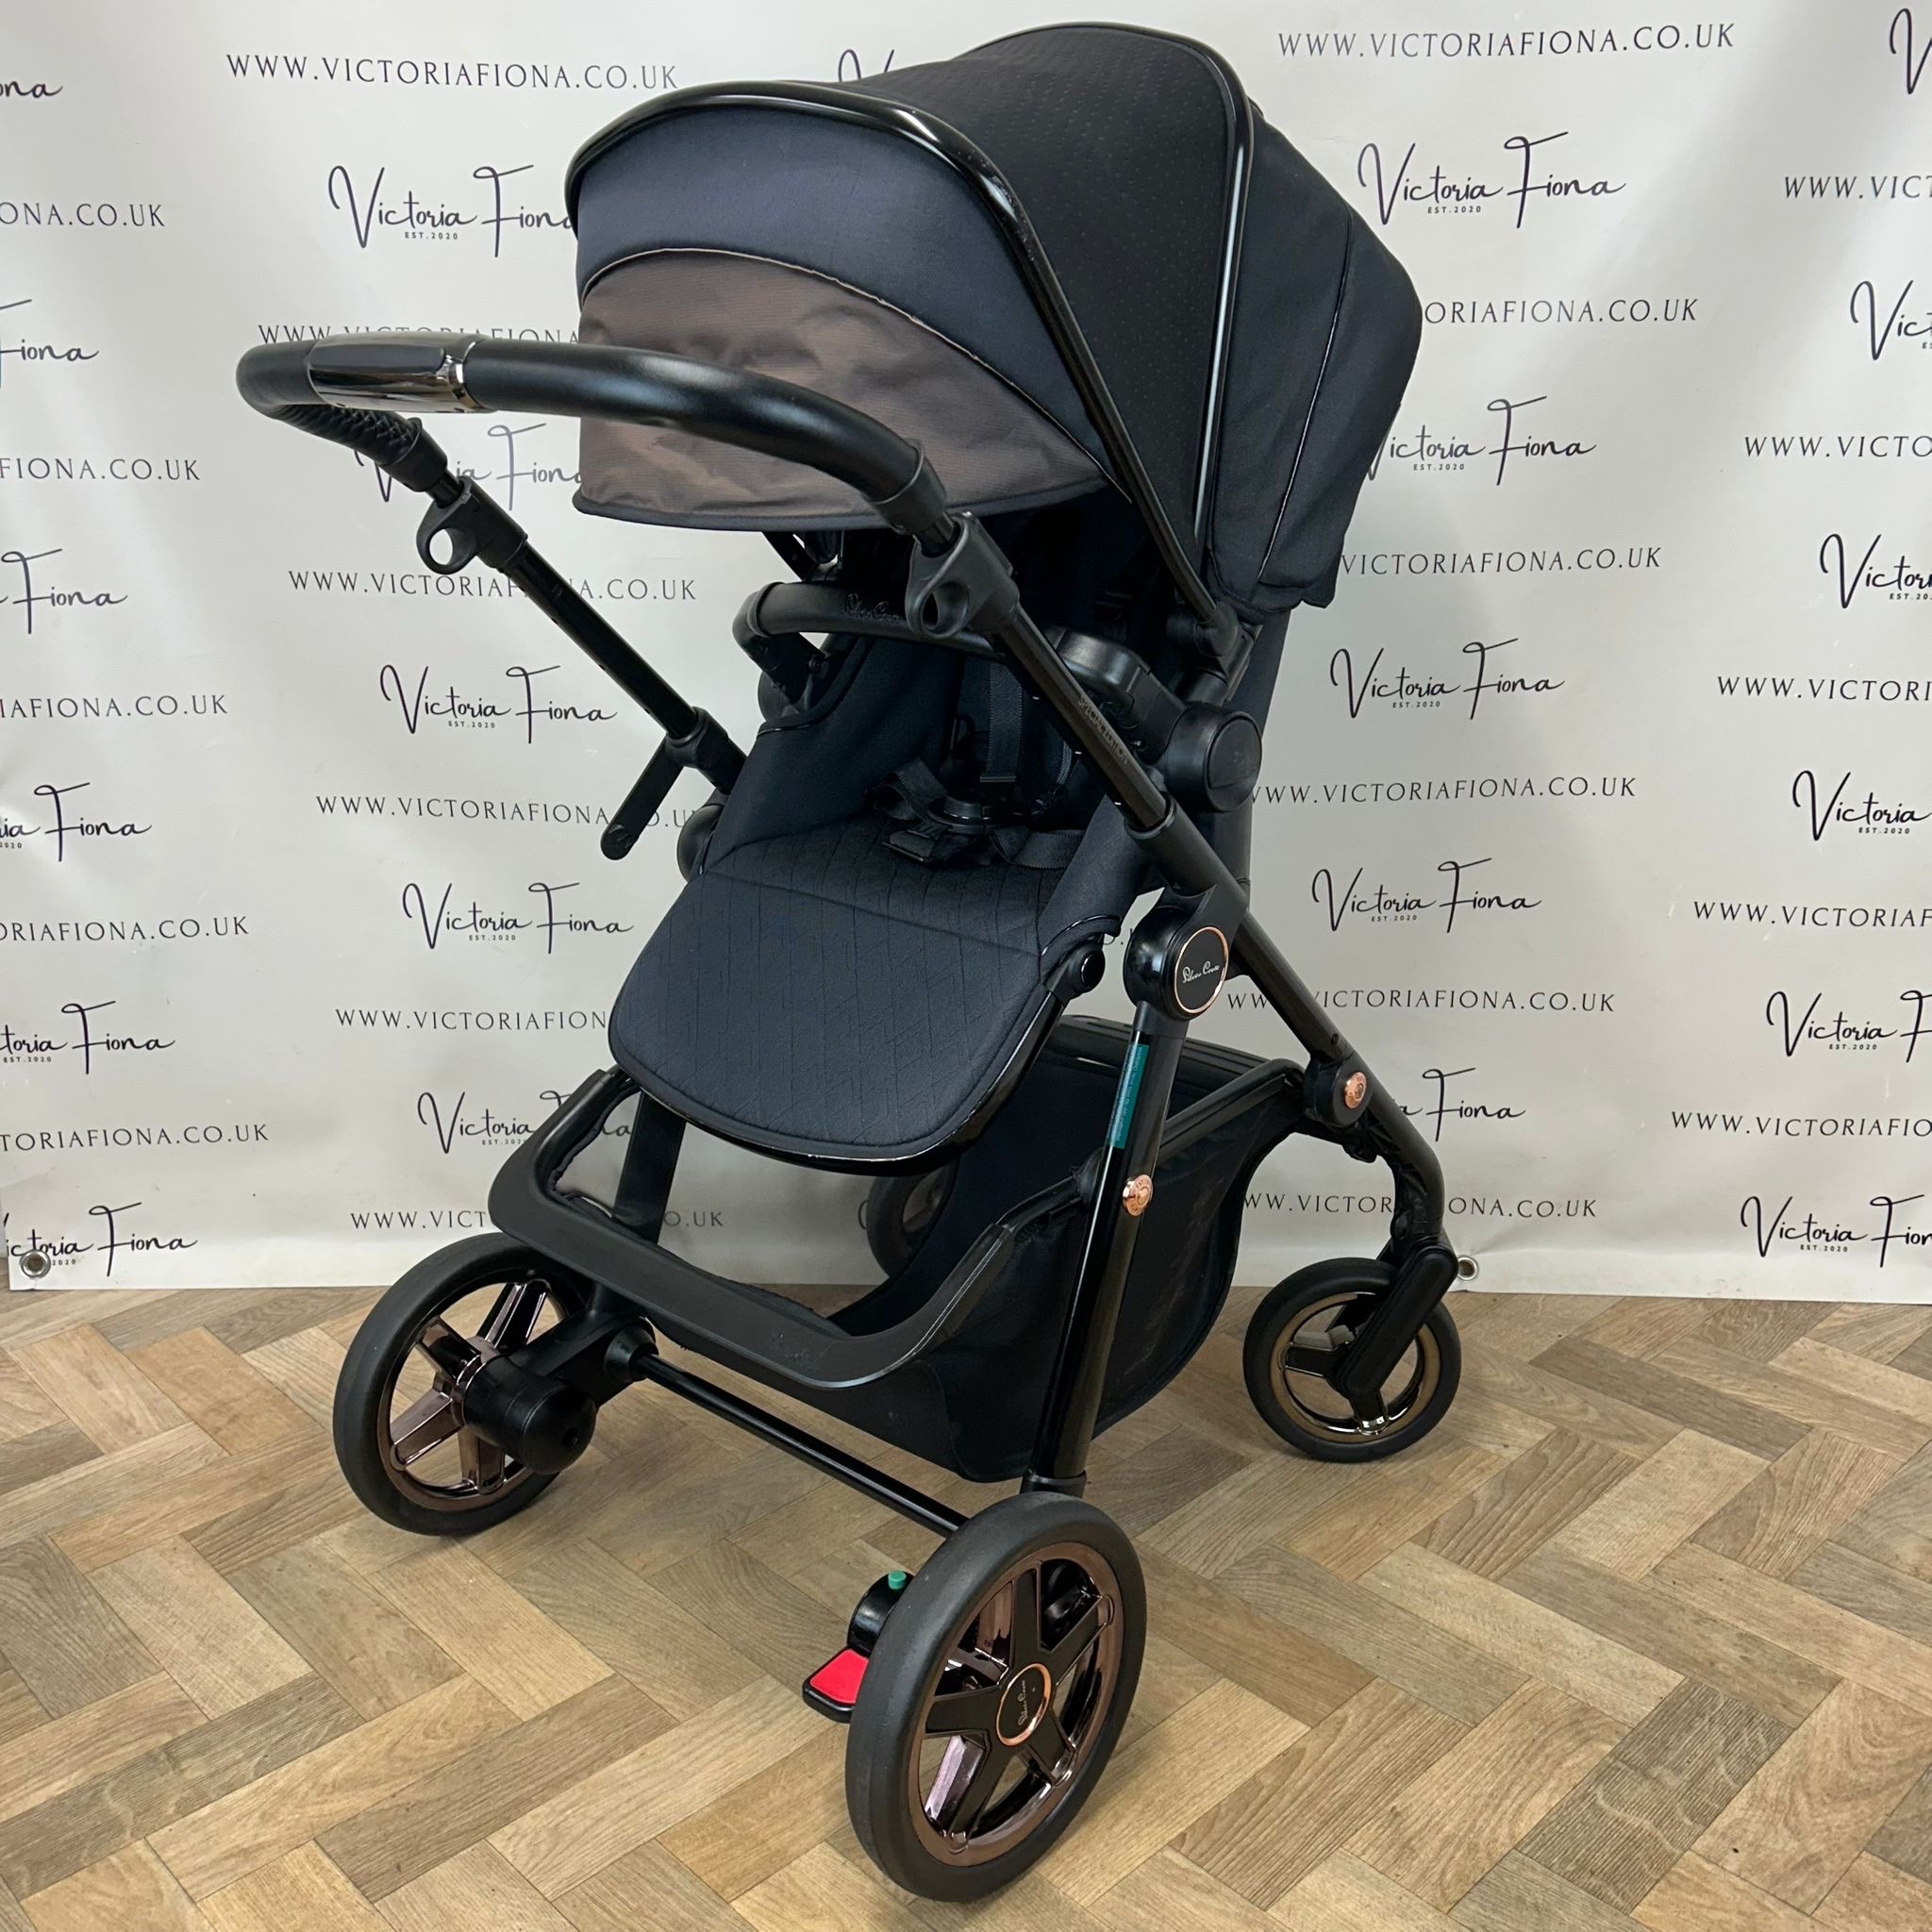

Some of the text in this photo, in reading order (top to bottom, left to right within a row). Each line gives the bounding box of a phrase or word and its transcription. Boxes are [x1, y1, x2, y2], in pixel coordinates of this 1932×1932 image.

[226, 55, 677, 89] WWW.VICTORIAFIONA.CO.UK
[1278, 24, 1734, 57] WWW.VICTORIAFIONA.CO.UK
[328, 165, 477, 248] Victoria
[1357, 131, 1626, 228] Victoria Fiona
[1850, 280, 1932, 360] Vic
[1487, 396, 1597, 486] Fiona
[0, 548, 128, 634] Fiona
[288, 570, 696, 601] WWW.VICTORIAFA.CO.UK
[1890, 592, 1932, 601] EST.20
[380, 665, 617, 743] Victoria Fiona
[1330, 638, 1565, 720] Victoria Fiona
[34, 782, 152, 862] Fiona
[1792, 771, 1932, 841] Victoria
[403, 883, 634, 954] Victoria Fiona
[1312, 858, 1541, 933] Victoria Fiona
[61, 1001, 175, 1074] Fiona
[1766, 991, 1898, 1057] Victoria
[417, 1091, 536, 1154] Victoria
[1423, 1068, 1525, 1142] Fiona
[4, 1203, 197, 1276] ictoria Fiona
[1740, 1196, 1868, 1257] Victoria
